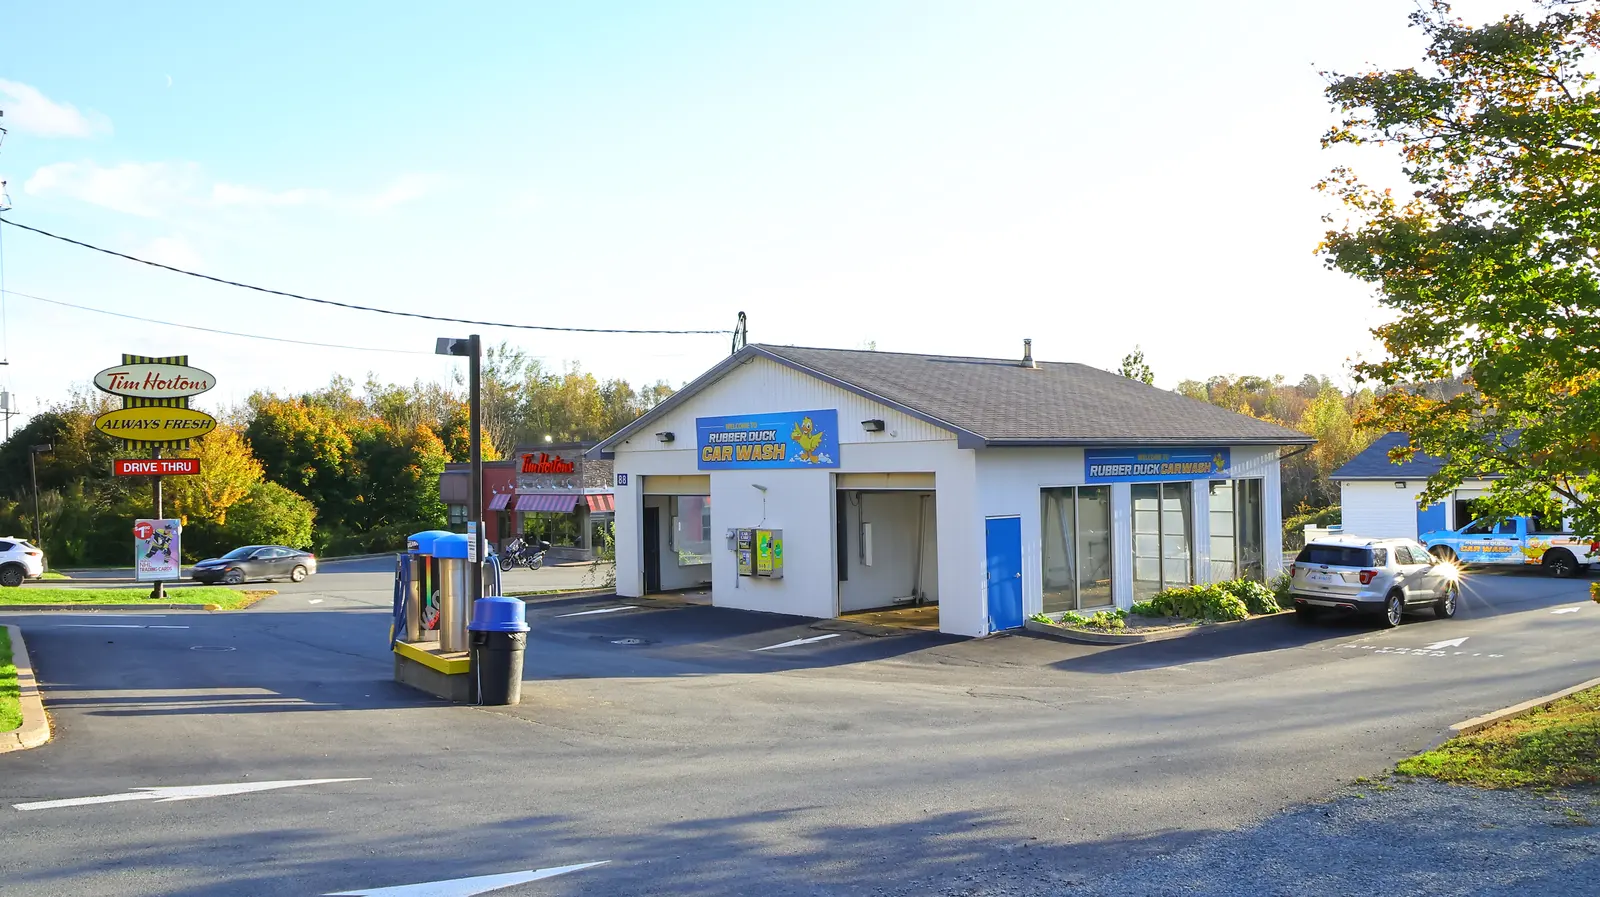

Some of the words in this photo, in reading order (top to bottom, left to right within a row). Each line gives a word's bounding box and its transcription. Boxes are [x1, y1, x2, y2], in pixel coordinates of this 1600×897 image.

[107, 372, 140, 390] Tim
[143, 371, 207, 390] Hortons
[101, 419, 160, 429] ALWAYS
[164, 419, 212, 429] FRESH
[709, 432, 747, 443] RUBBER
[748, 430, 776, 442] DUCK
[702, 445, 732, 461] CAR
[736, 444, 786, 460] WASH
[123, 462, 157, 472] DRIVE
[161, 462, 192, 472] THRU
[521, 453, 538, 473] Tim
[538, 453, 574, 473] Hortons
[1090, 464, 1131, 477] RUBBER
[1133, 463, 1160, 475] DUCK
[618, 475, 627, 485] 88
[1482, 545, 1512, 553] WASH
